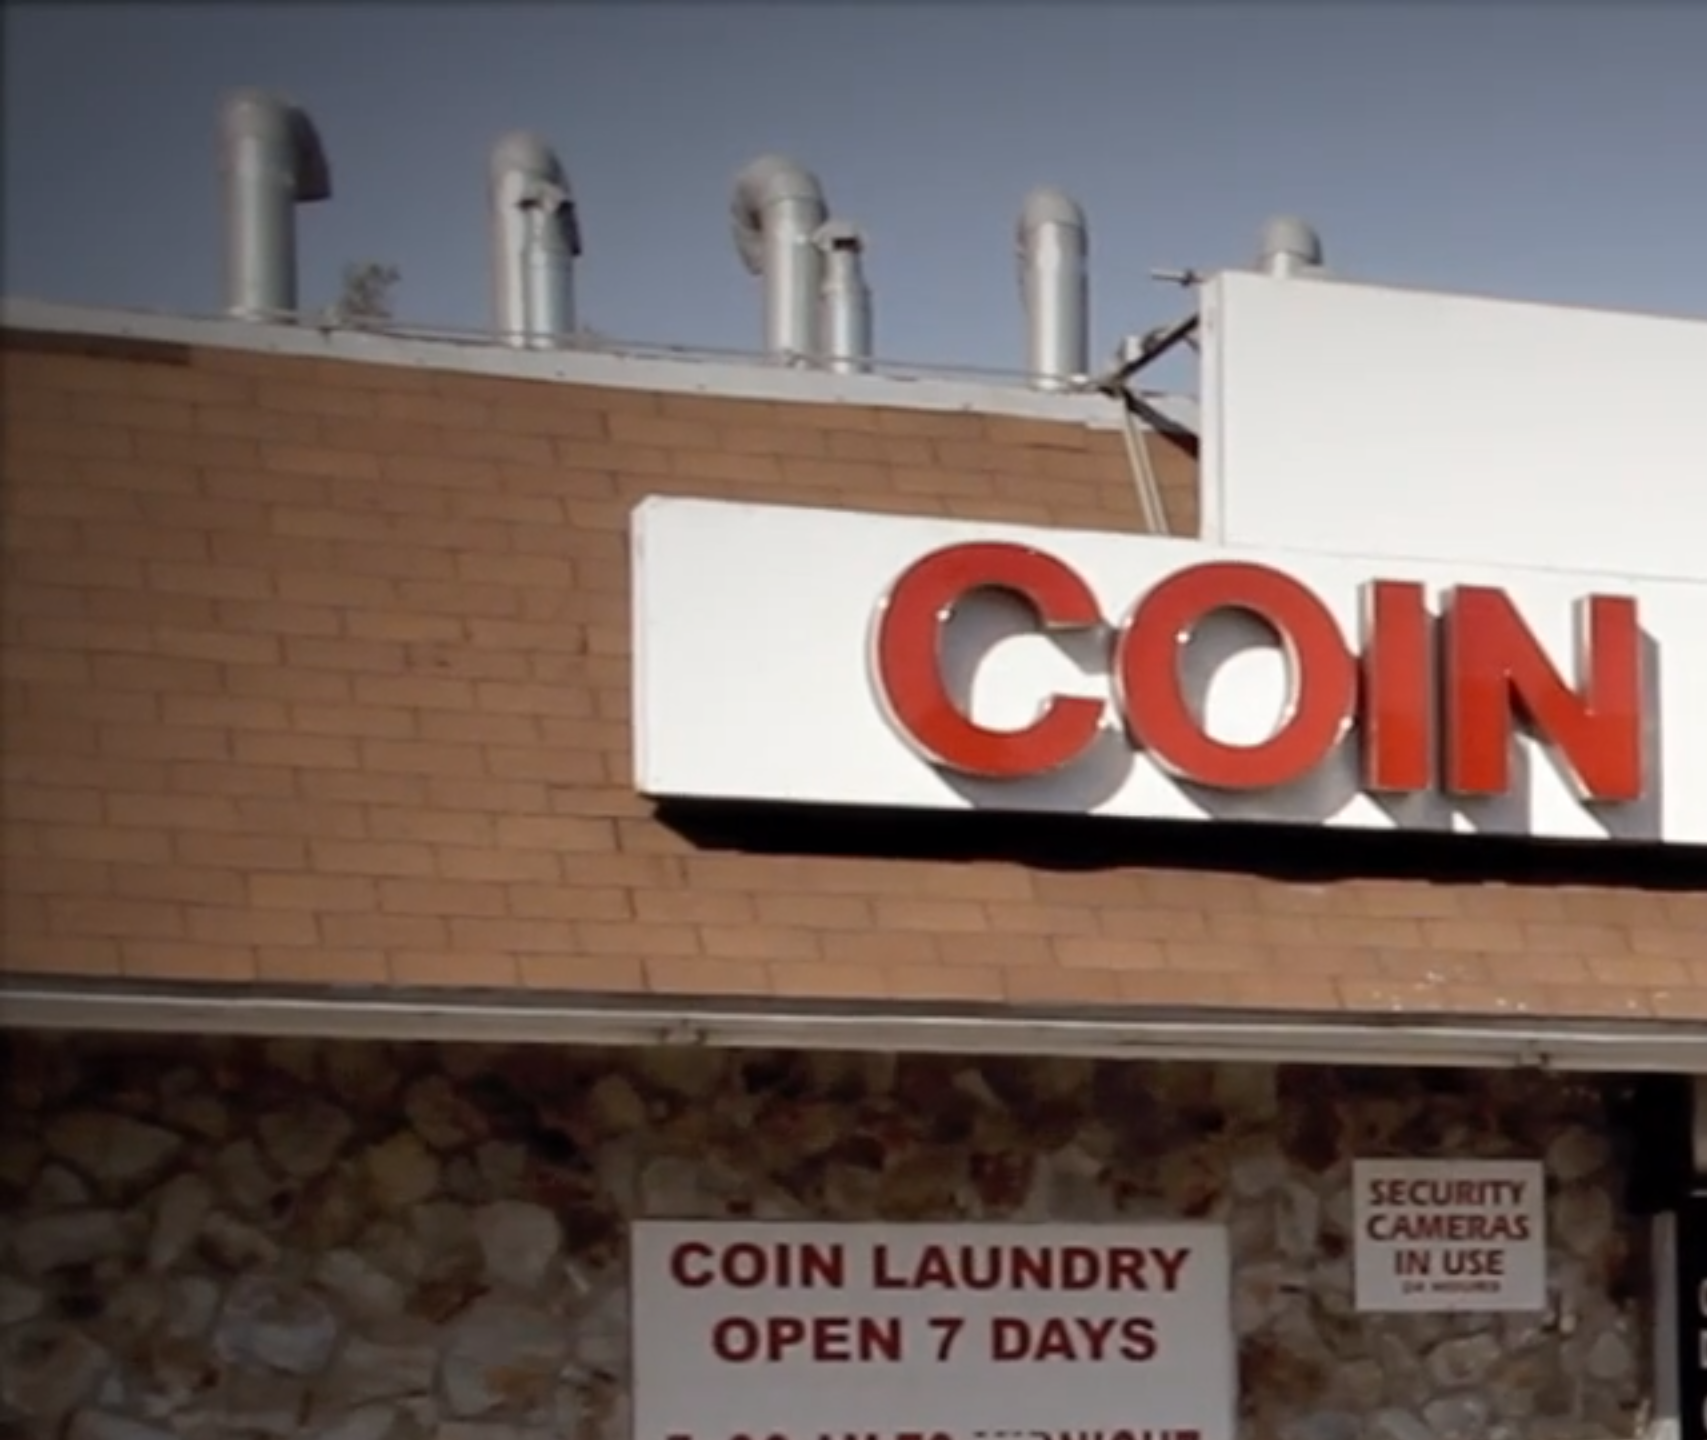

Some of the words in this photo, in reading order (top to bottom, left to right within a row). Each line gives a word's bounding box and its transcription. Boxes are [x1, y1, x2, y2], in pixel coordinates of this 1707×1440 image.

[870, 541, 1642, 800] COIN
[1369, 1179, 1526, 1206] SECURITY
[1367, 1215, 1529, 1241] CAMERAS
[670, 1241, 845, 1289] COIN
[873, 1244, 1191, 1292] LAUNDRY
[1394, 1250, 1430, 1275] IN
[1442, 1250, 1505, 1275] USE
[712, 1316, 902, 1363] OPEN
[928, 1317, 965, 1362] 7
[991, 1317, 1157, 1362] DAYS
